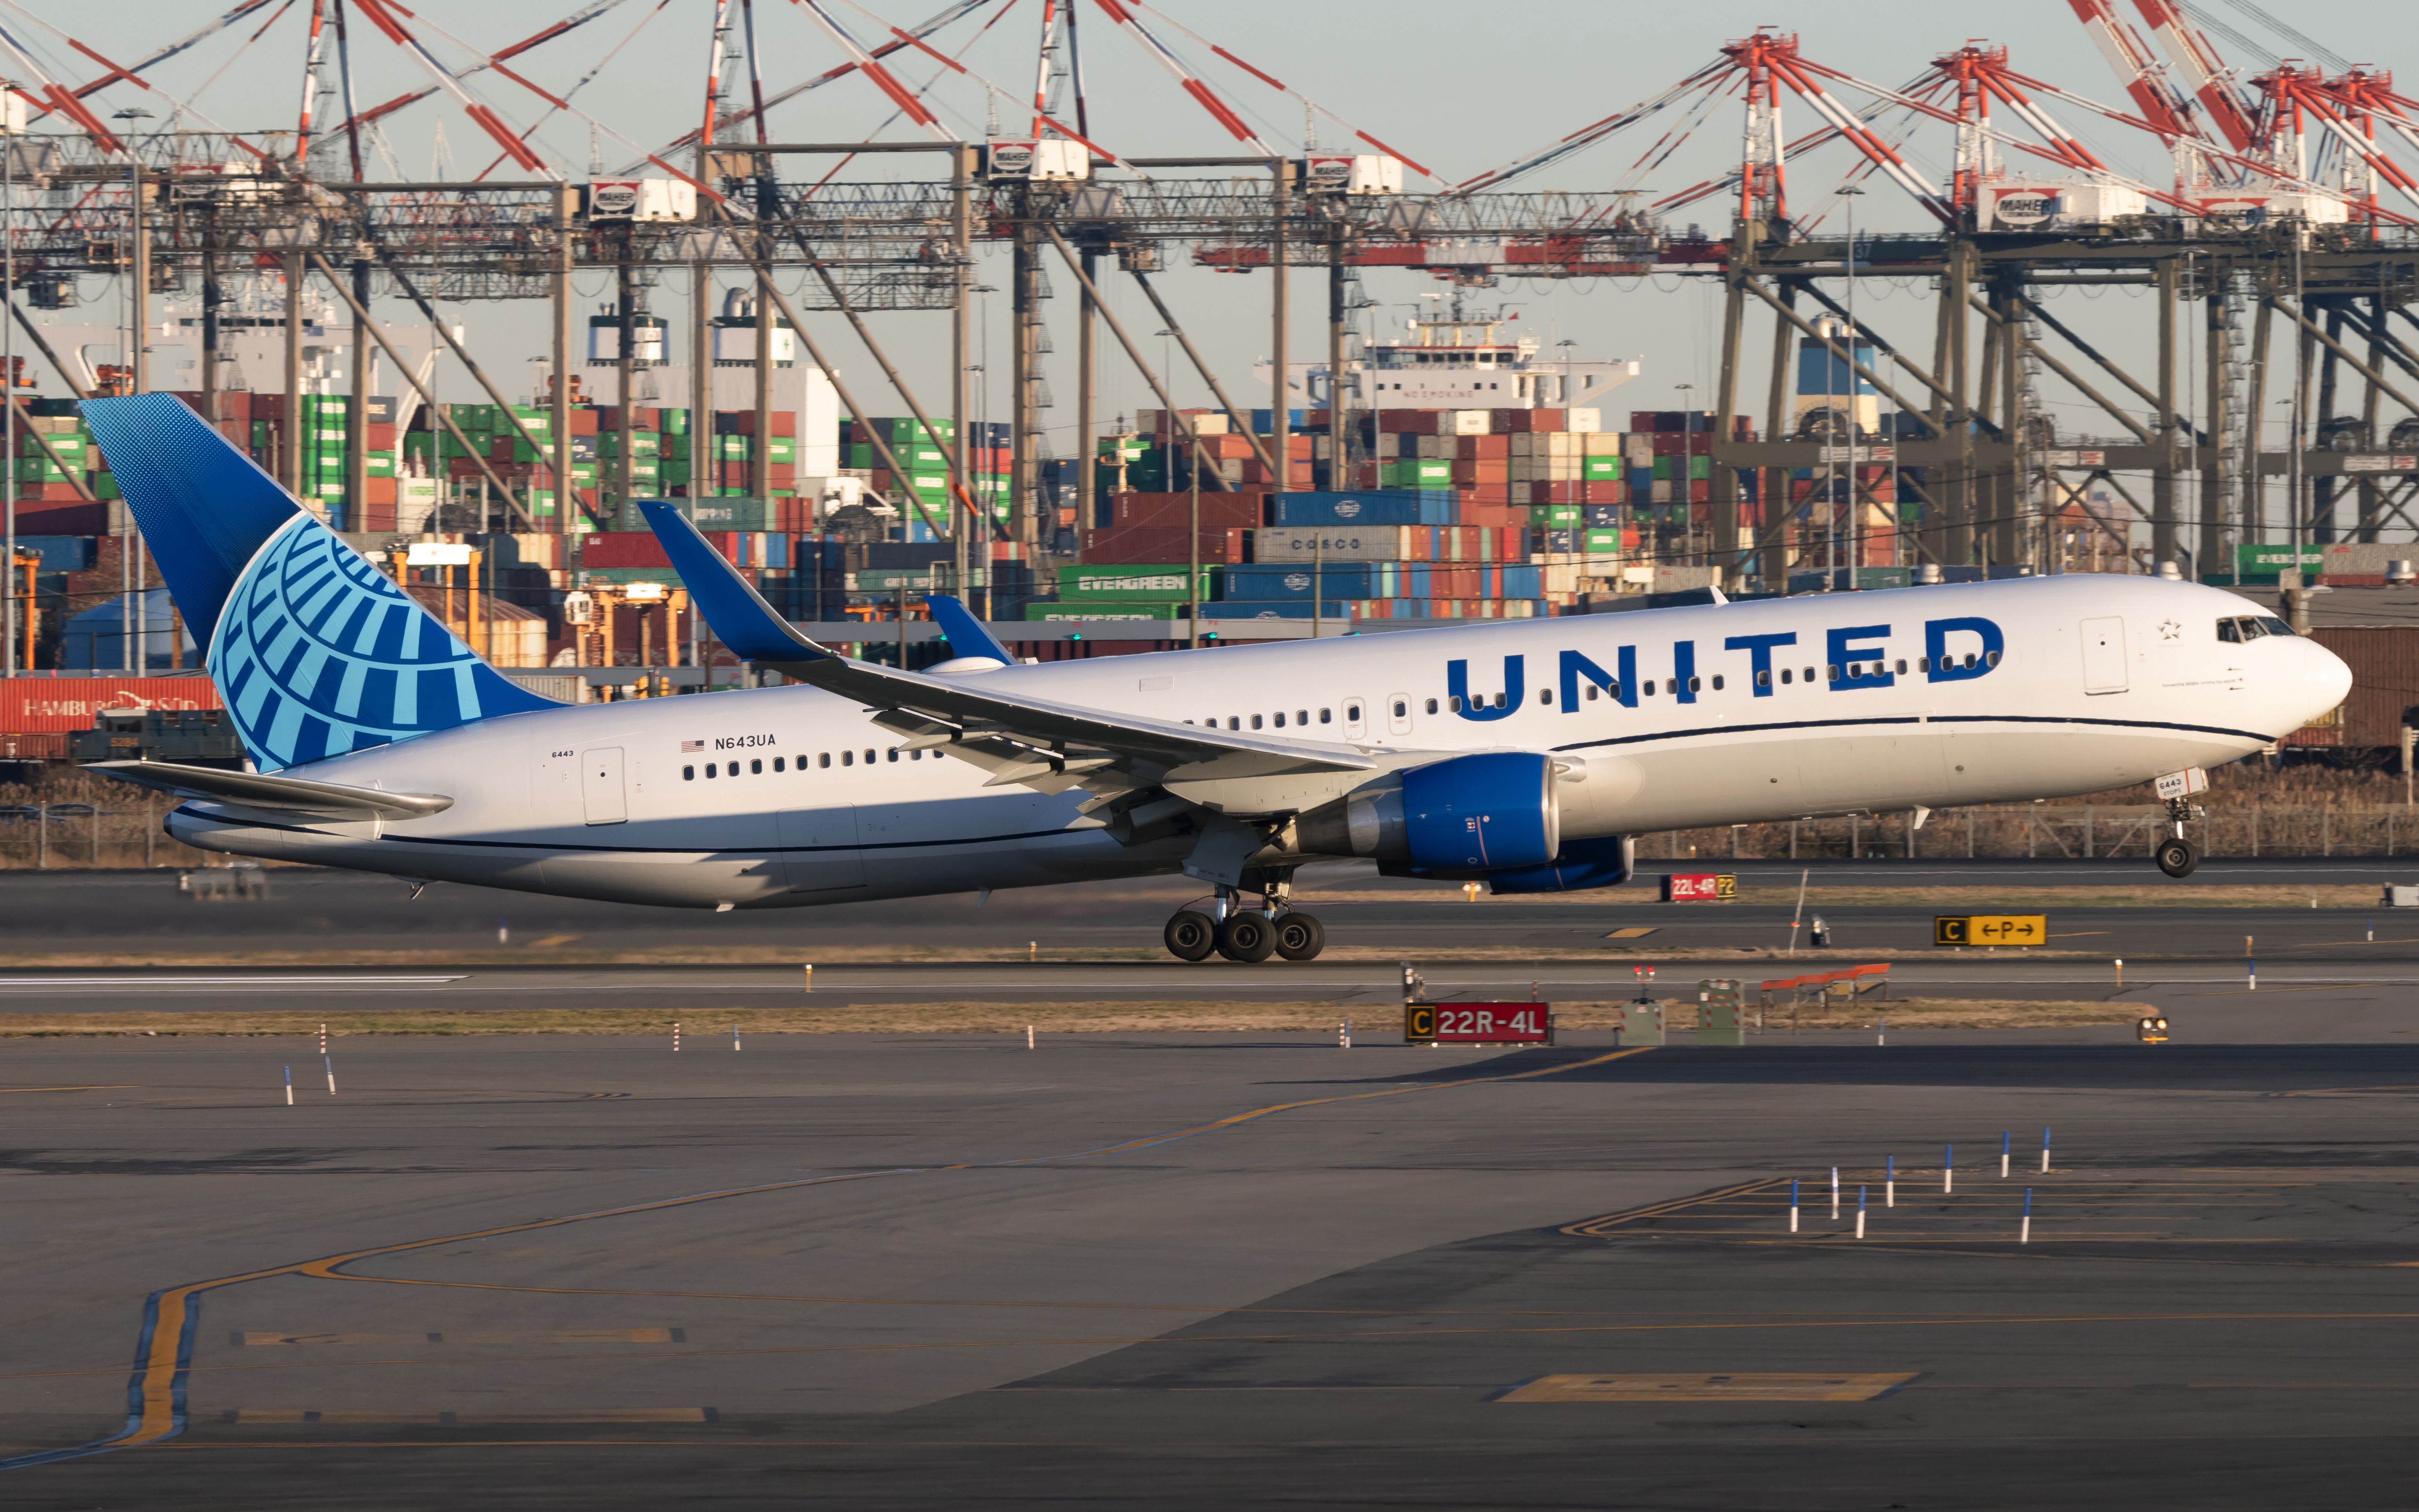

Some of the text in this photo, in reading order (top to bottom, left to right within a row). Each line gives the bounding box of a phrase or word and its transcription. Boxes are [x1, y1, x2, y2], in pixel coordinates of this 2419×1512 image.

[1999, 199, 2050, 211] MAHER
[1291, 539, 1359, 550] COSCO
[1079, 576, 1187, 590] EVERGREEN
[1447, 616, 2004, 722] UNITED
[715, 734, 776, 750] N643UA
[2159, 779, 2181, 789] 6443
[2163, 788, 2181, 796] ETOPS
[1673, 878, 1716, 895] 22L-4R
[1718, 878, 1734, 894] P2
[1945, 922, 1960, 940] C
[2001, 921, 2013, 939] P
[1413, 1011, 1431, 1034] C
[1438, 1011, 1545, 1034] 22R-4L
